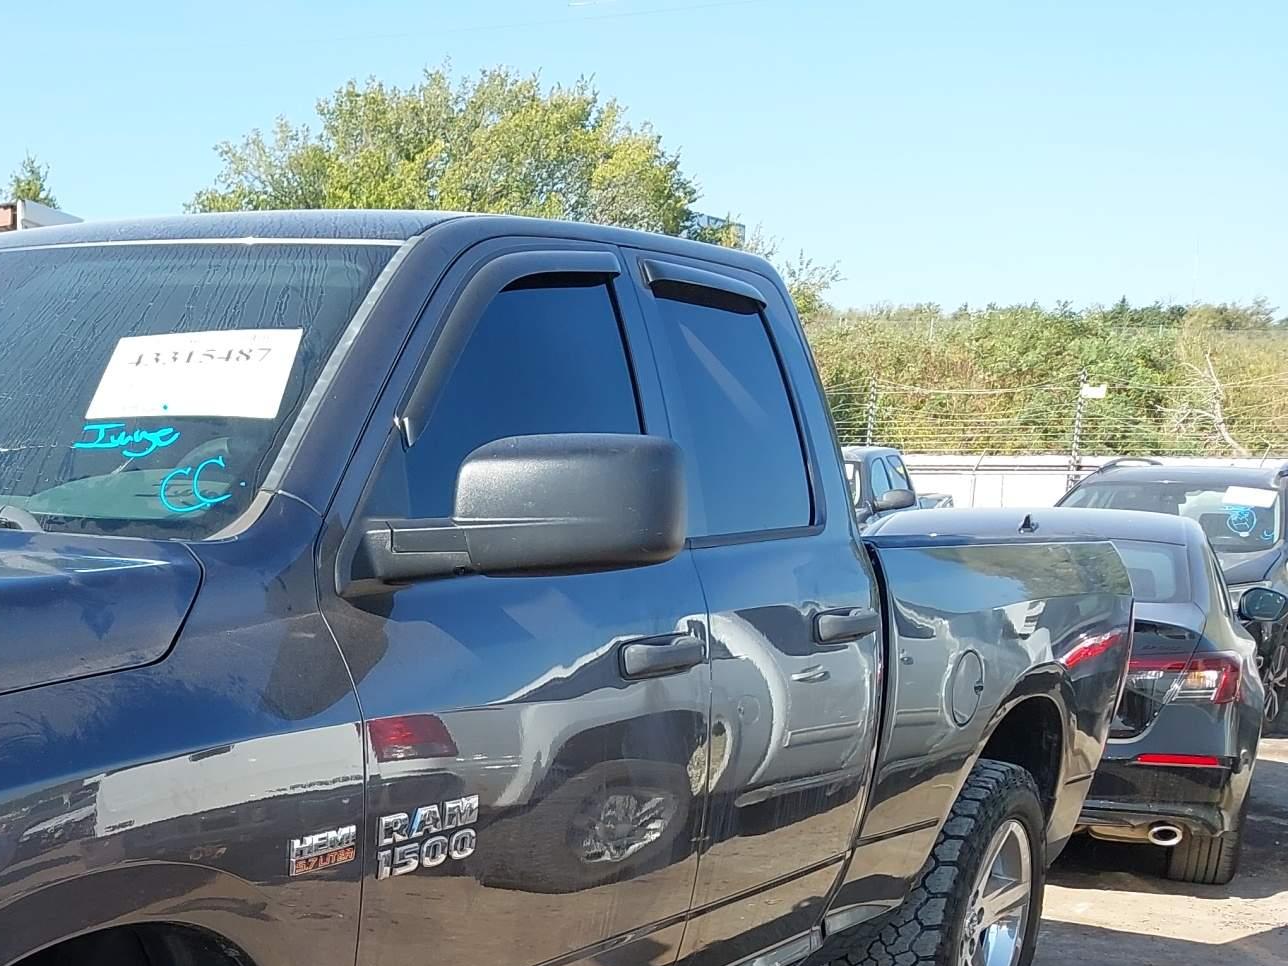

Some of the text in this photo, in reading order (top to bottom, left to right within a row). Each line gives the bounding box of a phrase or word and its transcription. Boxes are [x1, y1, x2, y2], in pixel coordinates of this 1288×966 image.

[127, 346, 273, 367] 43315487
[377, 794, 480, 847] RAM
[291, 825, 356, 859] HEMI
[377, 828, 478, 881] 1500
[295, 847, 355, 874] 5.7 LITER
